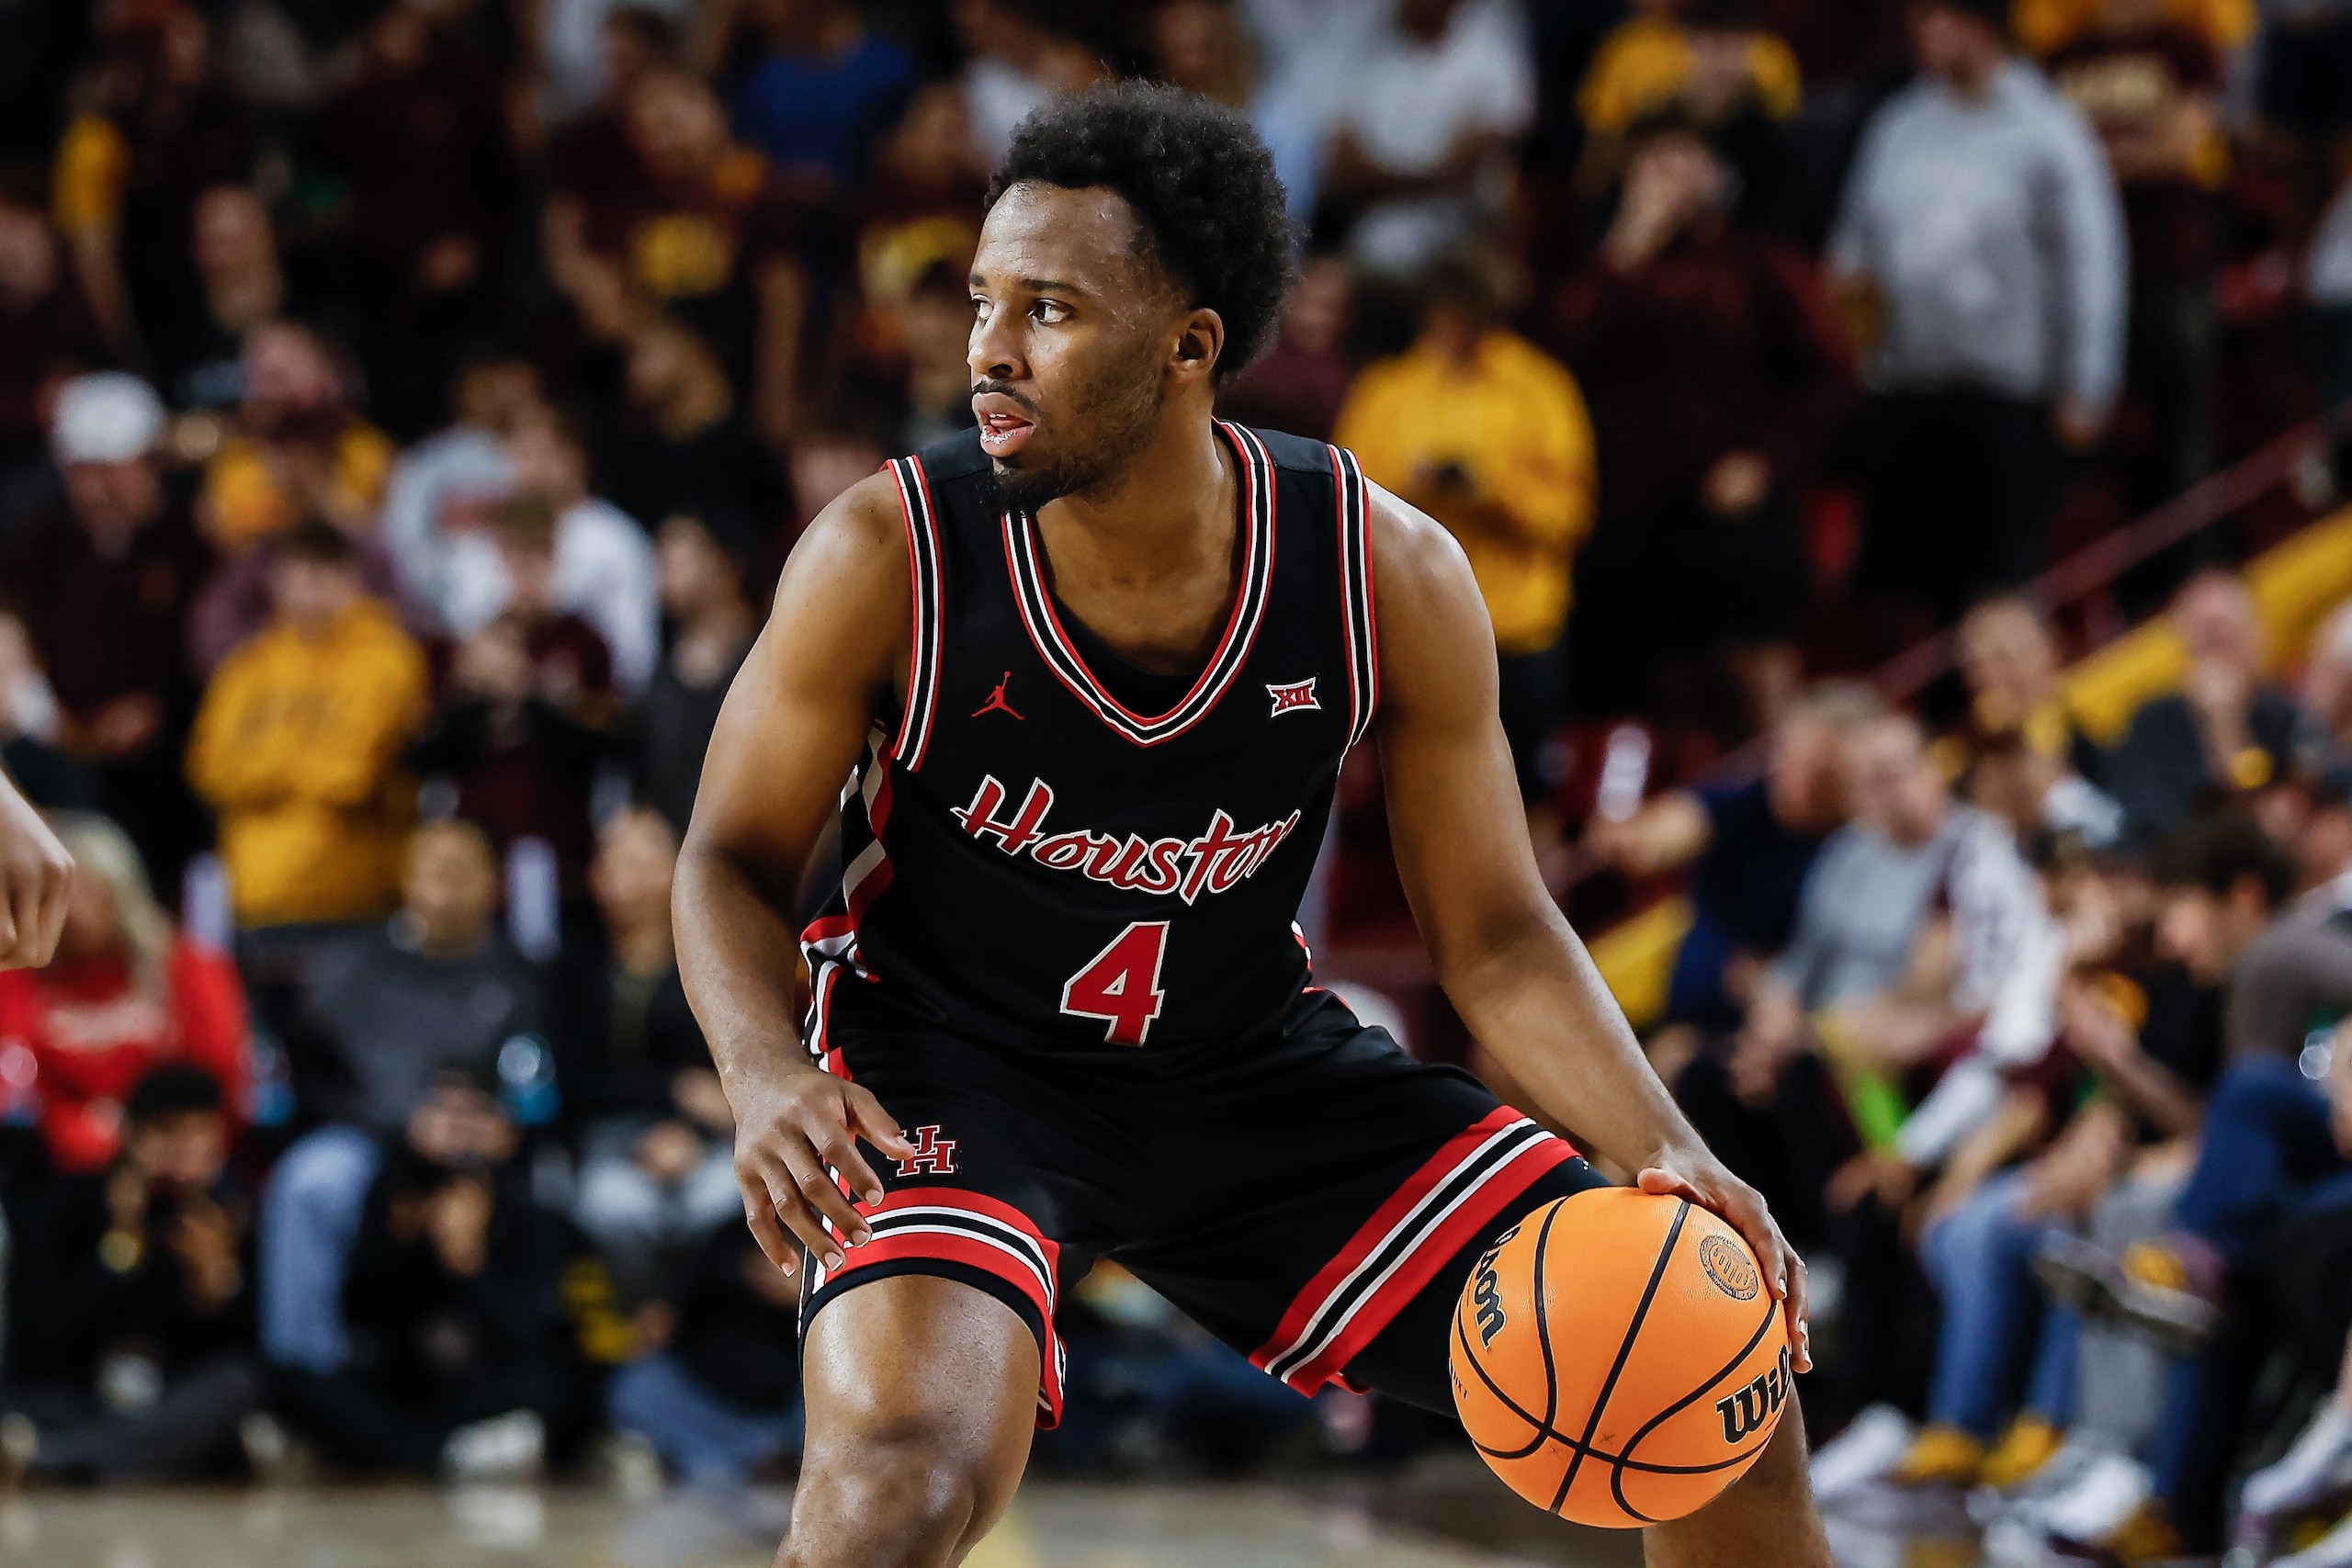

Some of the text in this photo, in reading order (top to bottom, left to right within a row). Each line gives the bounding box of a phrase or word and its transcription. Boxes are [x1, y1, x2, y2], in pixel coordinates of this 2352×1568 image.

[1269, 680, 1319, 716] XII
[950, 774, 1301, 906] Houston
[1059, 920, 1170, 1047] 4
[1715, 1345, 1791, 1445] Wil
